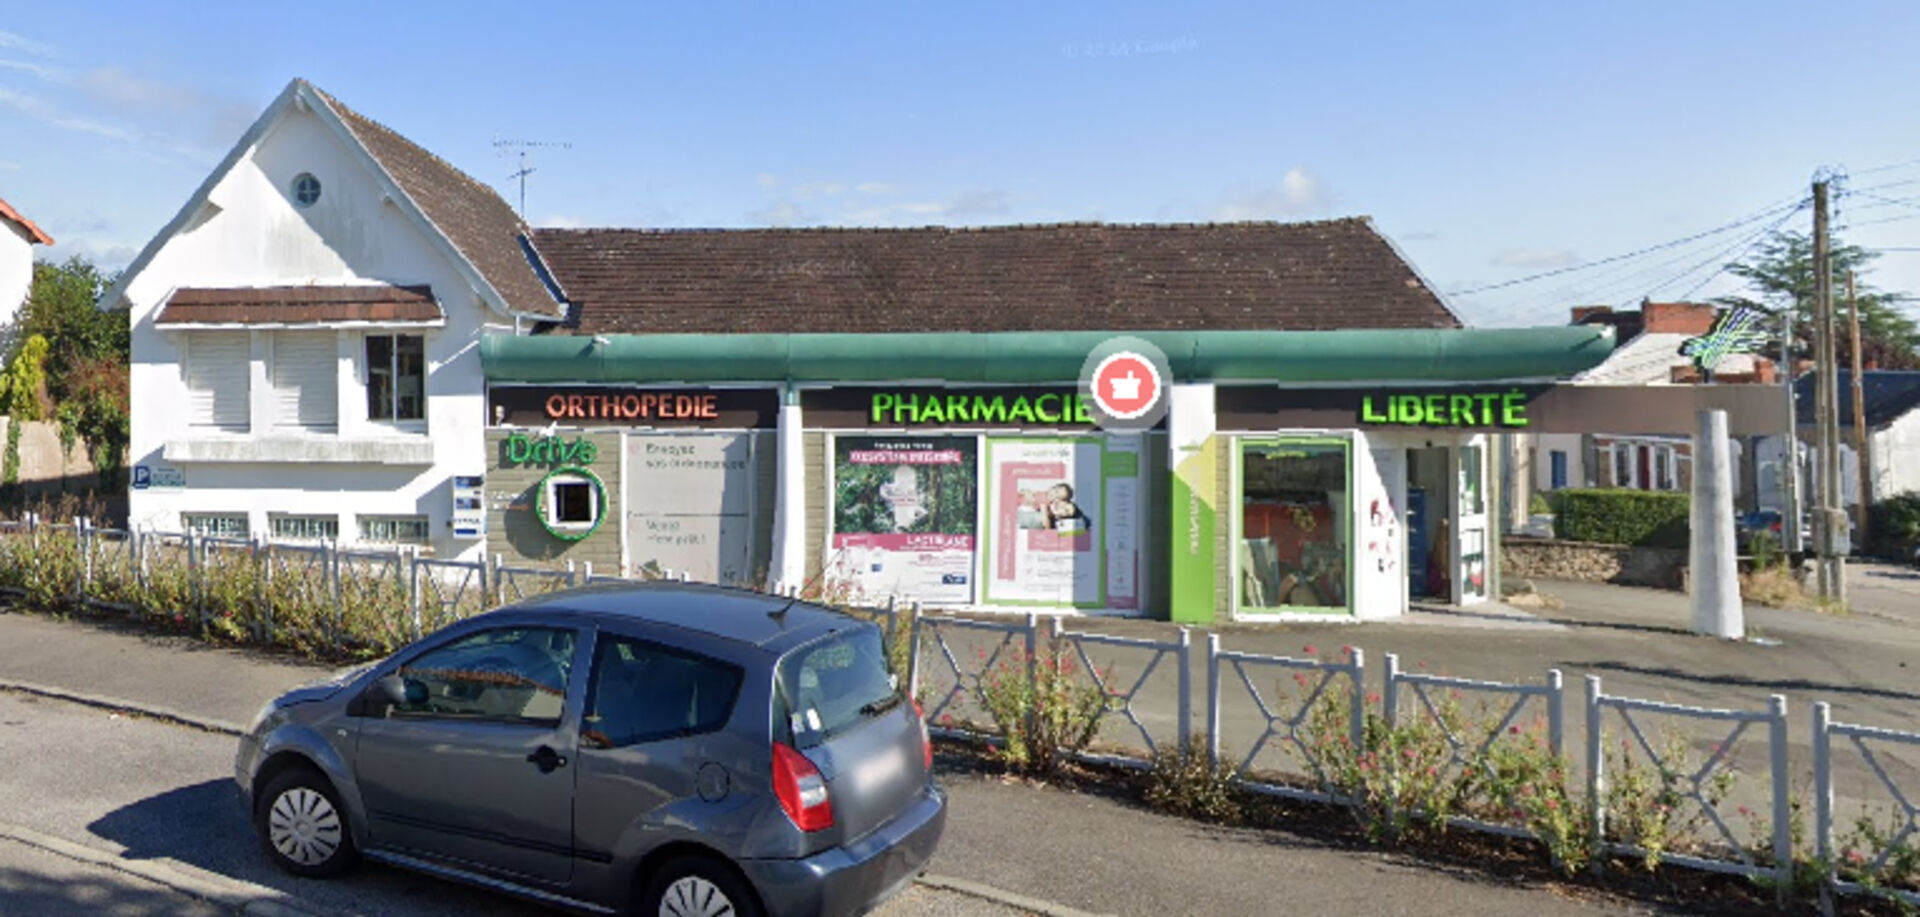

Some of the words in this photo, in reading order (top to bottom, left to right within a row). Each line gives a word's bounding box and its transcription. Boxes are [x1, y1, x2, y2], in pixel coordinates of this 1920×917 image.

[546, 394, 719, 420] ORTHOPEDIE
[871, 393, 1096, 424] PHARMACIE
[1362, 388, 1530, 427] LIBERTÉ
[508, 434, 598, 465] Drive
[137, 468, 149, 482] P
